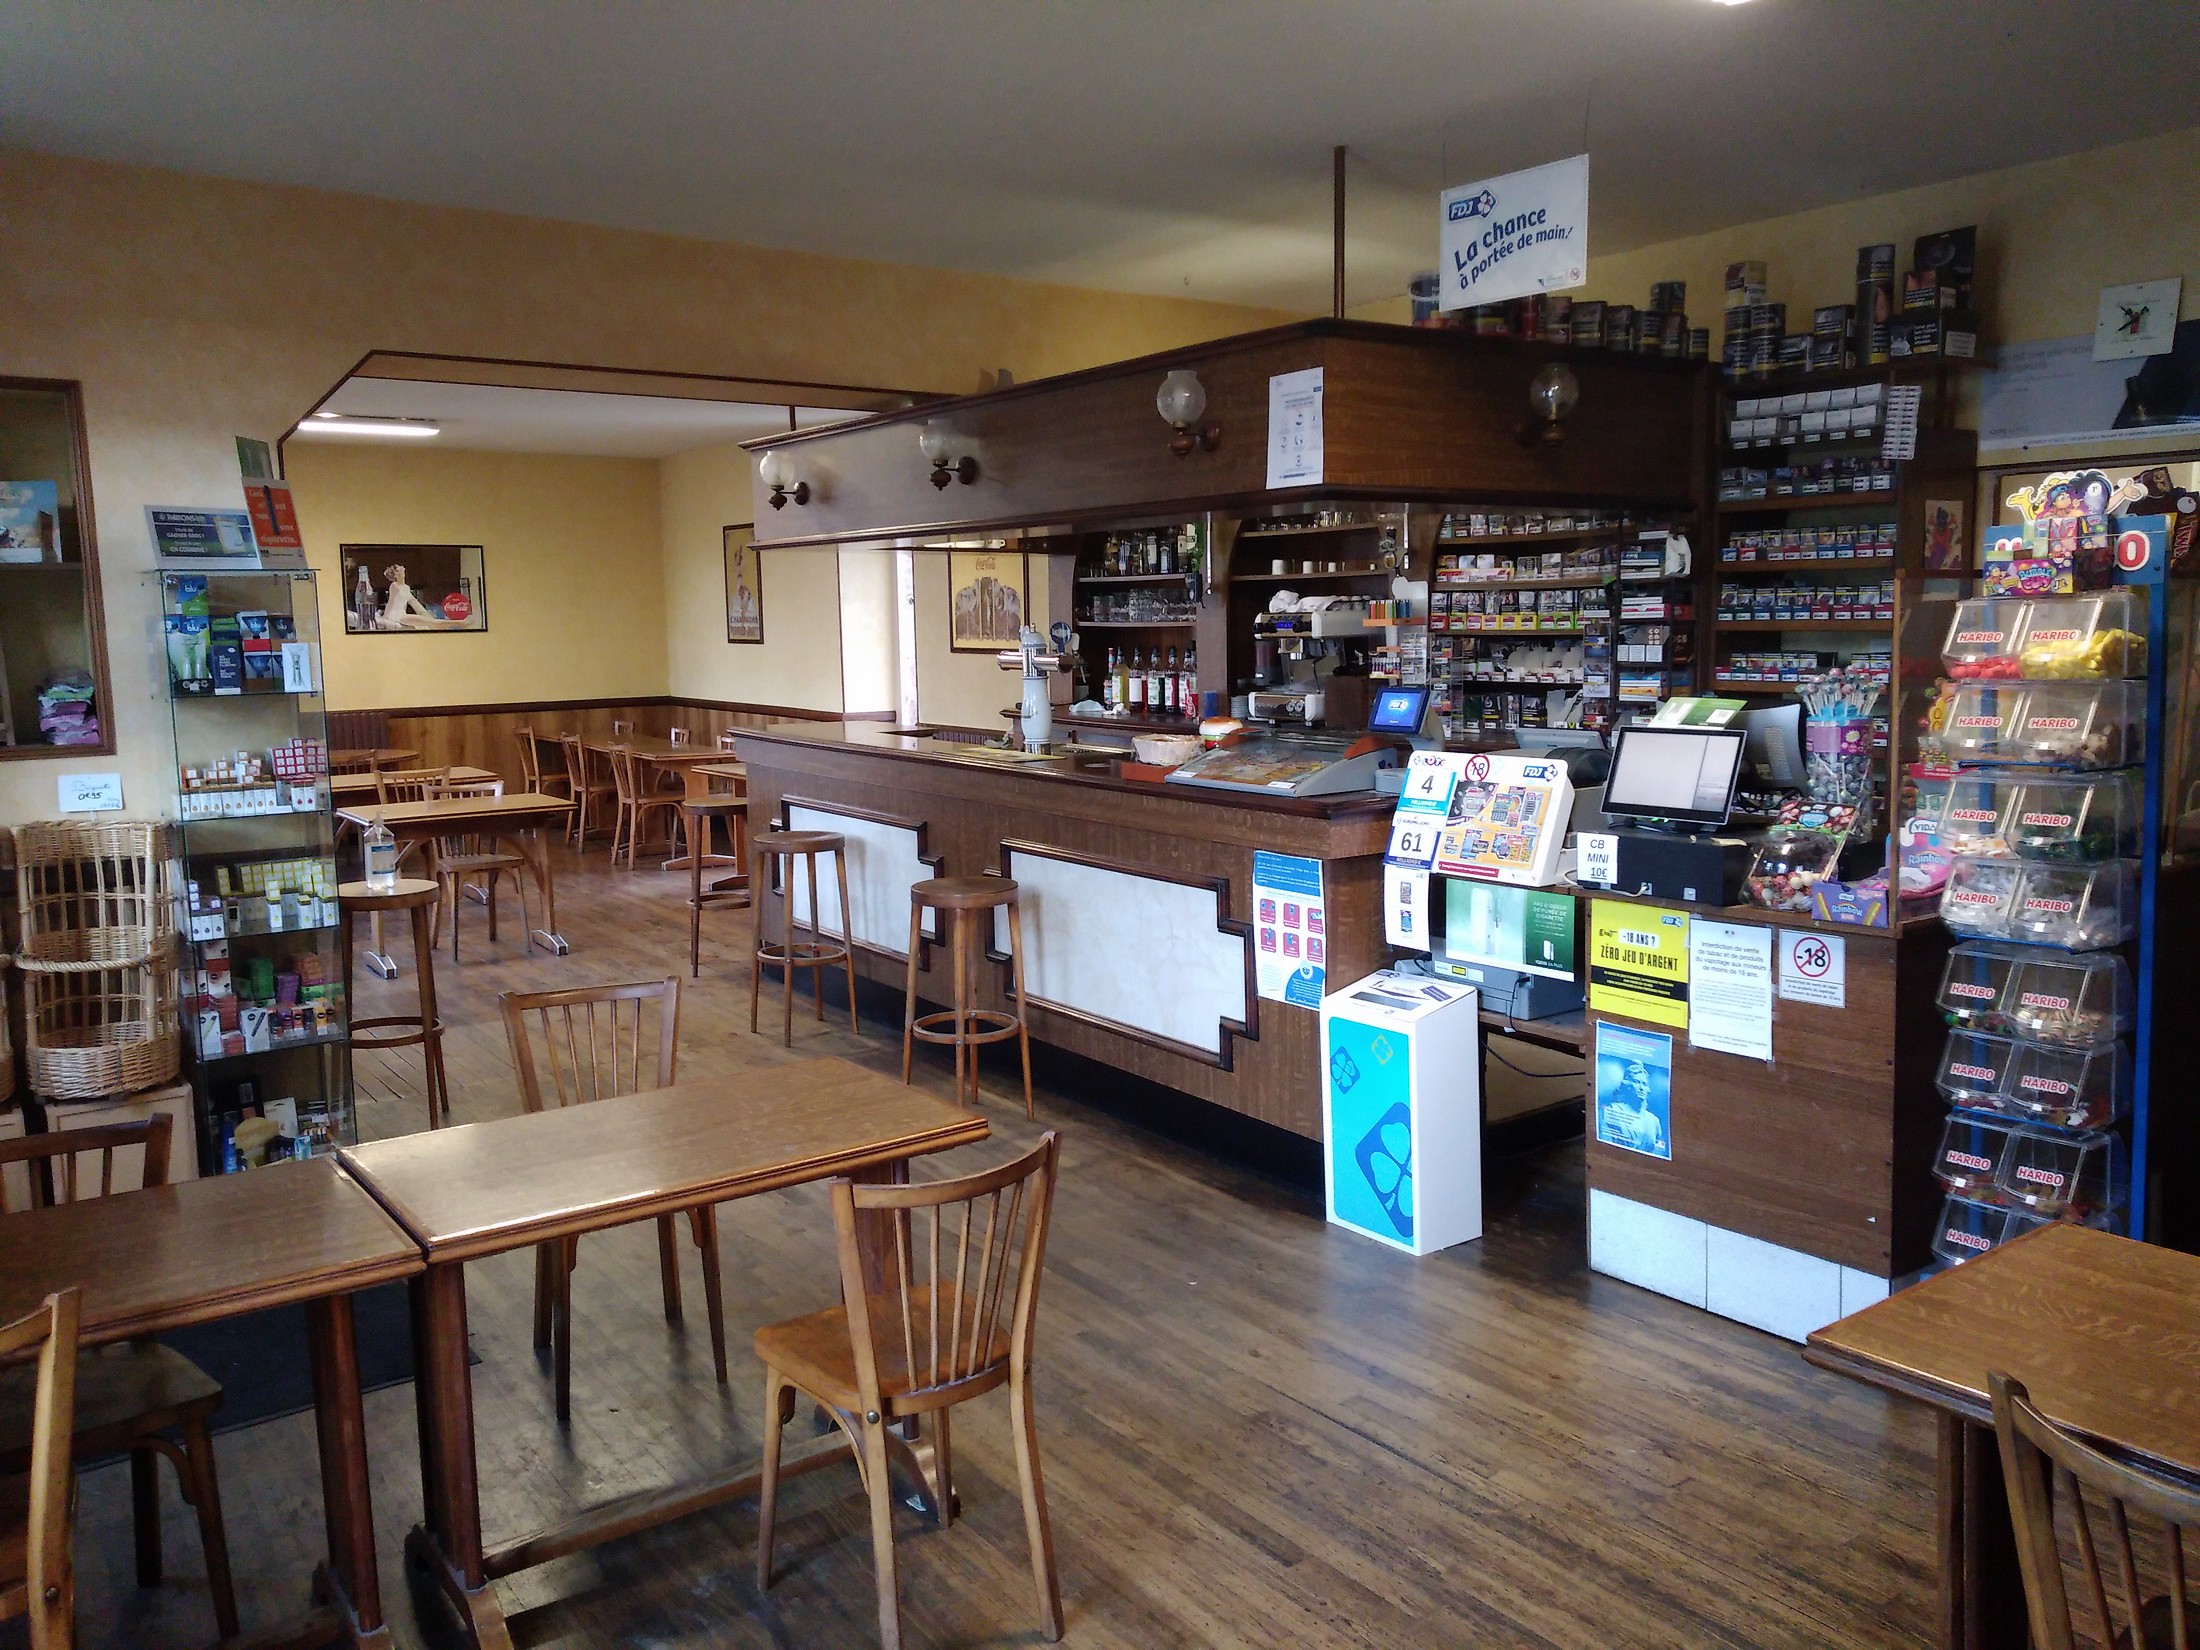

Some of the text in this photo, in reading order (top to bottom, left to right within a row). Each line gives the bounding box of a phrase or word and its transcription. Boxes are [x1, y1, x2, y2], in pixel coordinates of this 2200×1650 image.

[1450, 200, 1473, 218] FDJ
[1454, 208, 1546, 272] La chance
[1460, 273, 1469, 289] à
[1472, 243, 1513, 285] portée
[1517, 231, 1532, 250] de
[187, 623, 199, 631] blu
[1959, 632, 2002, 643] HARIBO
[2032, 630, 2078, 641] HARIBO
[1957, 717, 2002, 728] HARIBO
[2031, 717, 2077, 729] HARIBO
[1524, 768, 1543, 776] FDJ
[1421, 776, 1434, 793] 4
[1953, 810, 1996, 822] HARIBO
[2024, 814, 2070, 826] HARIBO
[1401, 832, 1422, 852] 61
[1590, 839, 1605, 849] CB
[1587, 853, 1609, 863] MINI
[1591, 867, 1607, 877] 10€
[1955, 893, 1997, 905] HARIBO
[2026, 899, 2071, 911] HARIBO
[1832, 905, 1863, 916] Rainbow
[1622, 932, 1634, 943] -18
[1636, 934, 1649, 946] ANS
[1601, 944, 1678, 971] ZÉRO JEU D'ARGENT
[1797, 947, 1826, 967] -18
[1951, 984, 1995, 998] HARIBO
[2023, 994, 2068, 1009] HARIBO
[1951, 1064, 1995, 1080] HARIBO
[2021, 1076, 2067, 1093] HARIBO
[1947, 1152, 1990, 1170] HARIBO
[2016, 1167, 2063, 1185] HARIBO
[1947, 1231, 1990, 1250] HARIBO
